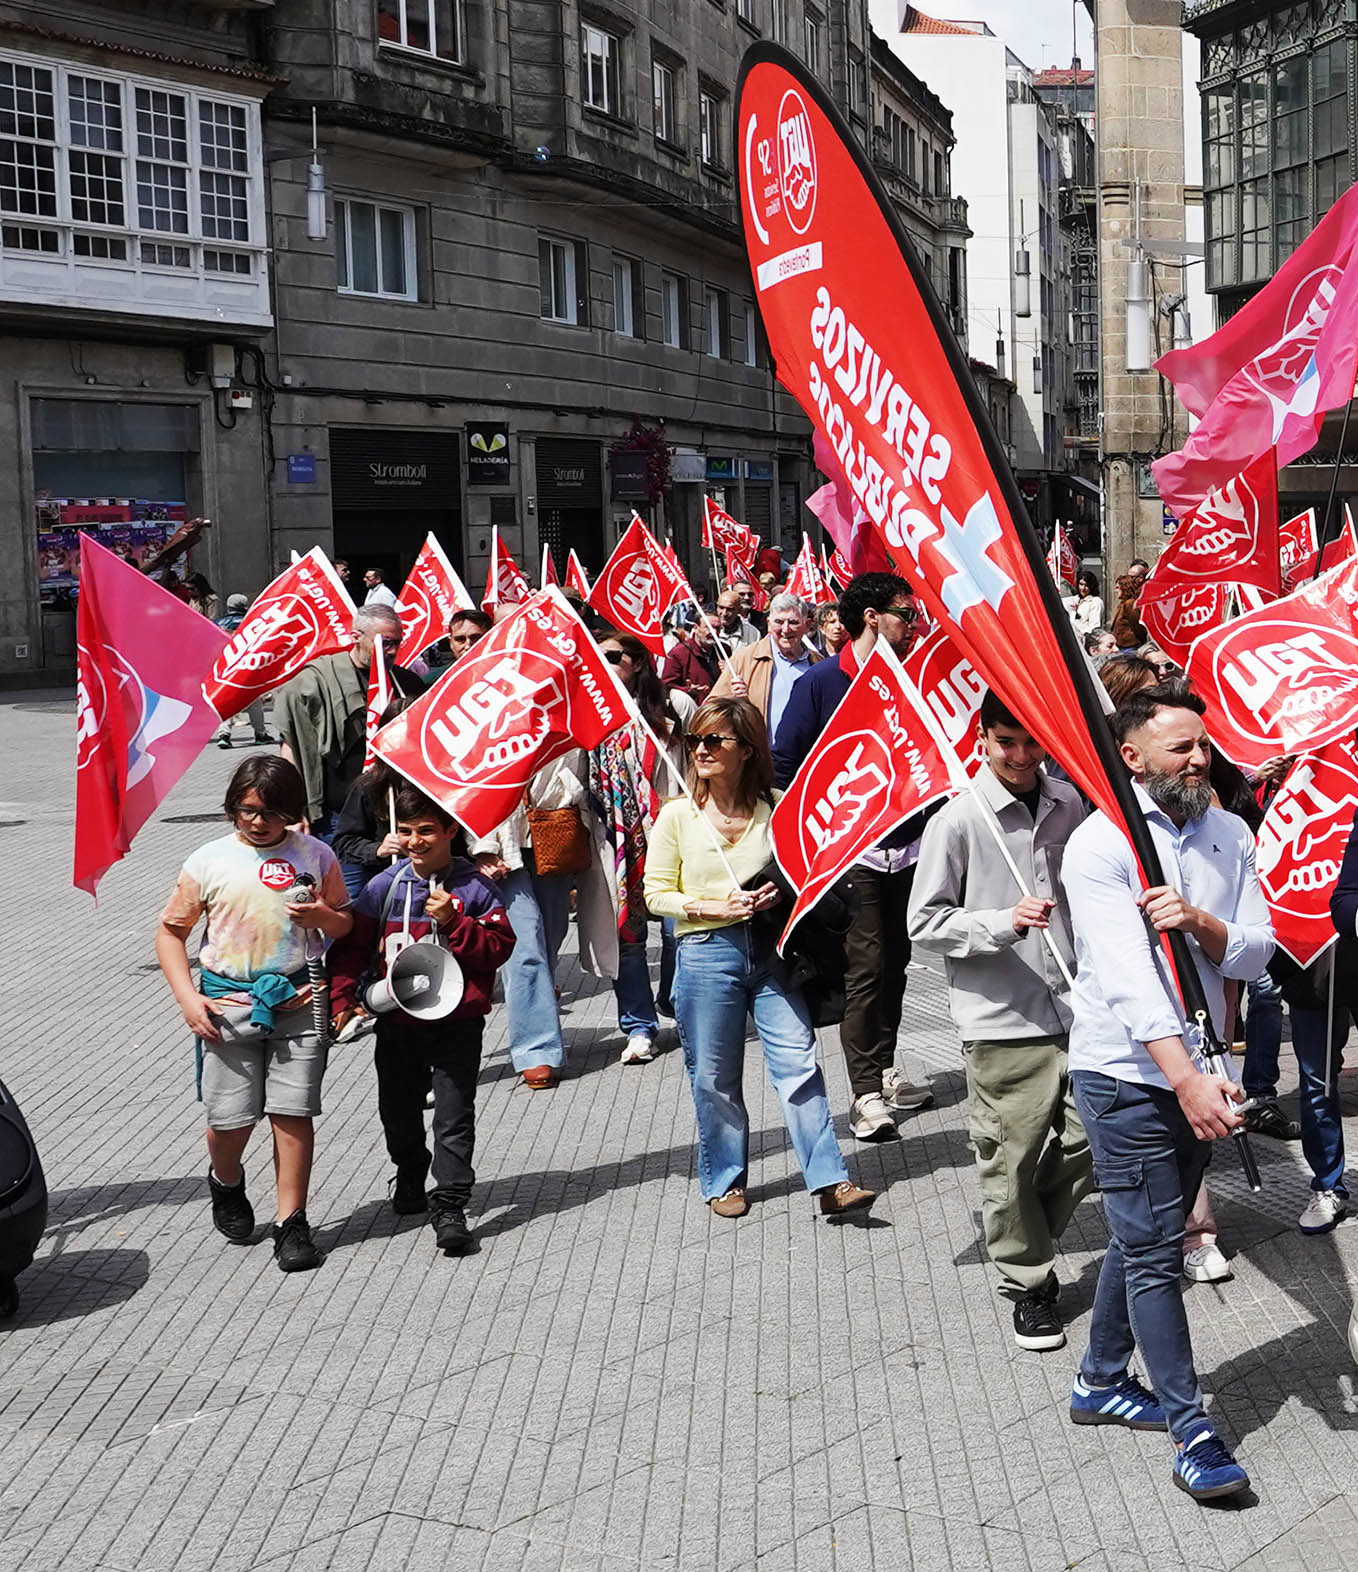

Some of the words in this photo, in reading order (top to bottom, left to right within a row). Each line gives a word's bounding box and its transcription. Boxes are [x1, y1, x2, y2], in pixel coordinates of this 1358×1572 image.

[430, 656, 535, 755] UGT
[528, 607, 613, 726] www.UGT.es
[927, 658, 988, 742] UG
[1222, 632, 1345, 705] UGT
[868, 674, 931, 798] www.UGT.es
[262, 862, 291, 879] UGT
